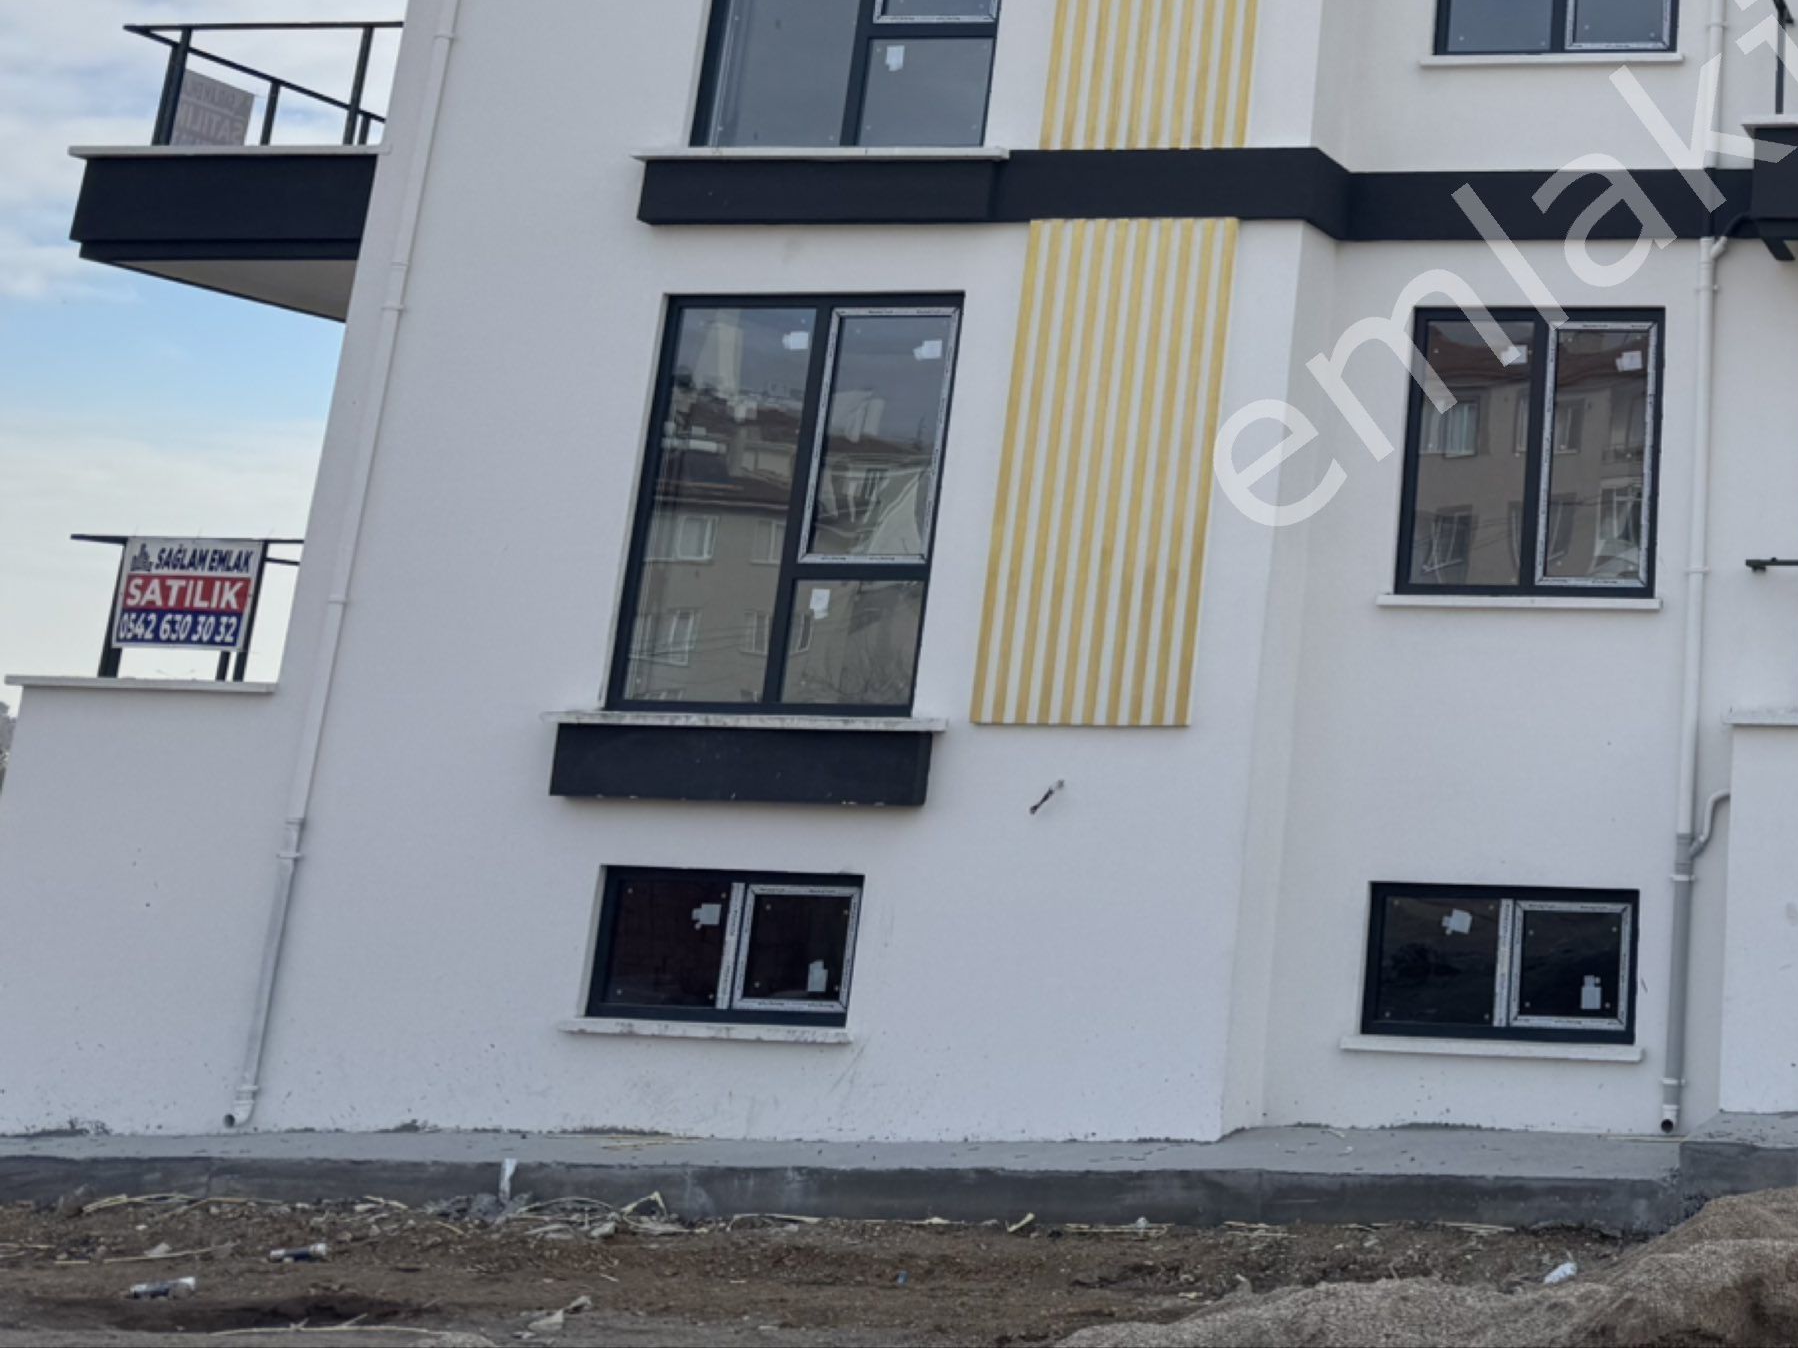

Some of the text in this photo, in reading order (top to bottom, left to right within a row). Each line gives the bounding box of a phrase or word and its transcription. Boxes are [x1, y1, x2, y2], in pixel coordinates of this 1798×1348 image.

[156, 544, 253, 573] SAĞLAM EMLAK
[126, 579, 243, 608] SATILIK
[118, 611, 239, 643] 0542 630 30 32
